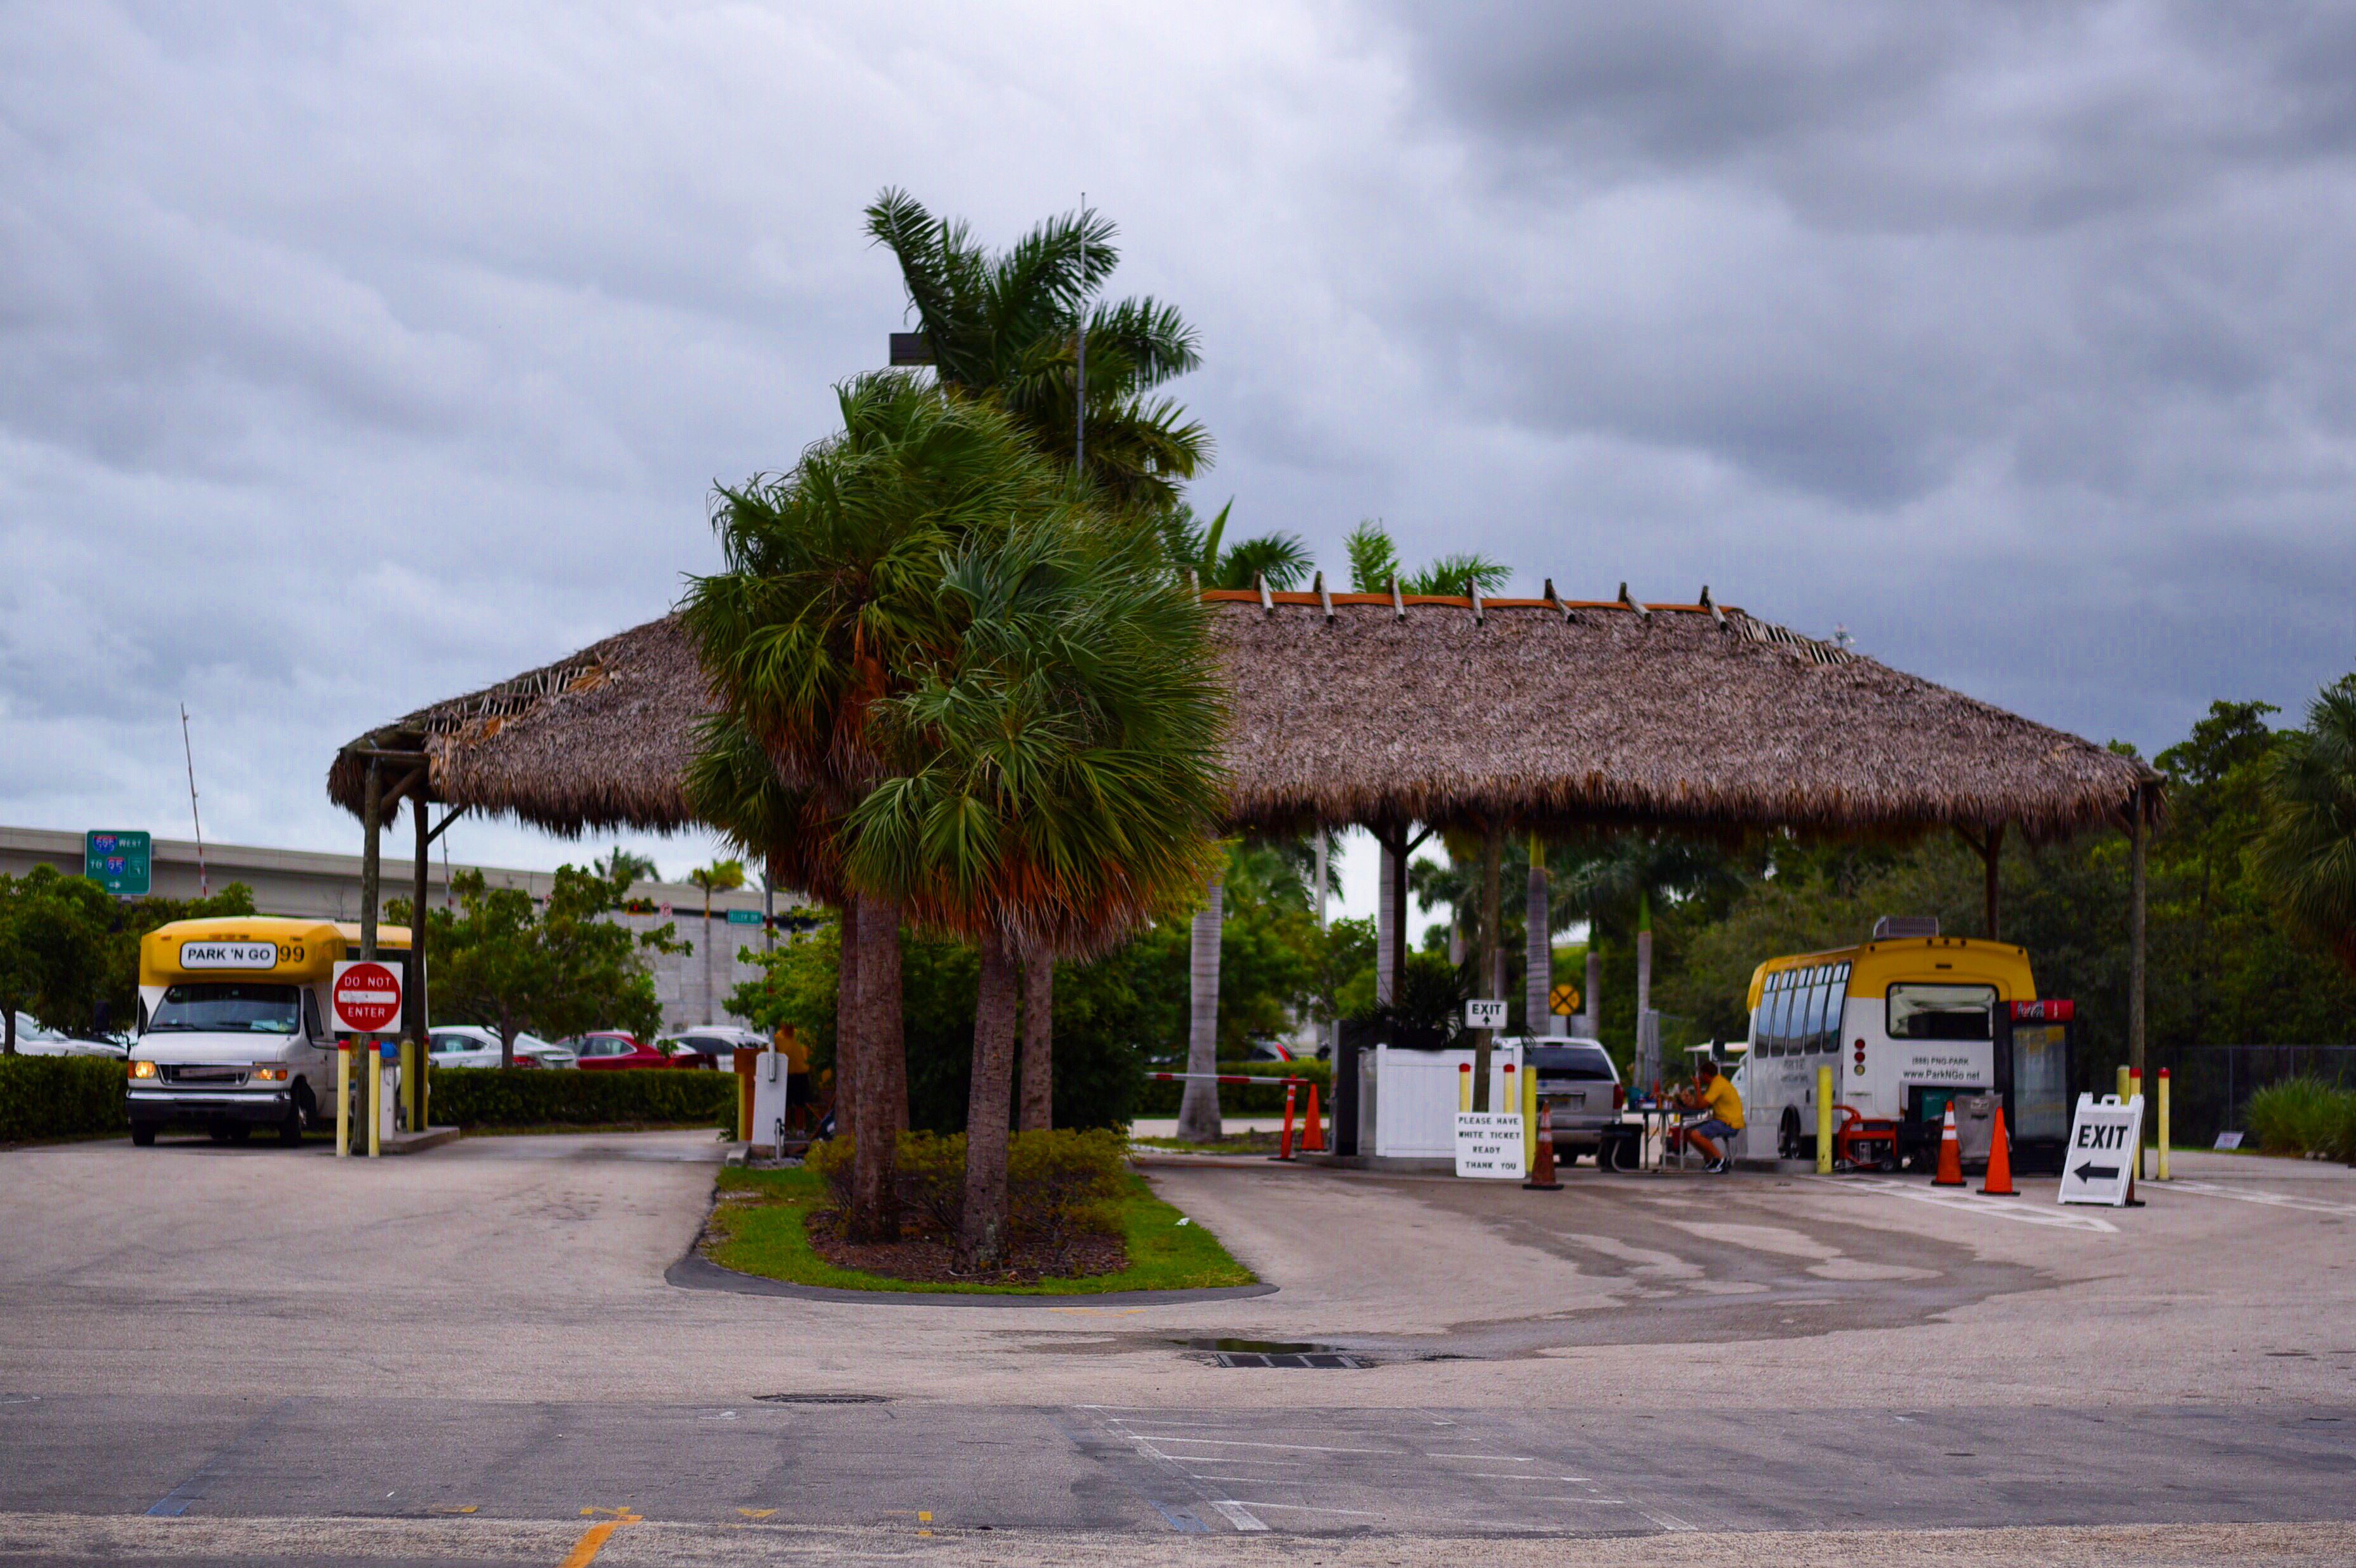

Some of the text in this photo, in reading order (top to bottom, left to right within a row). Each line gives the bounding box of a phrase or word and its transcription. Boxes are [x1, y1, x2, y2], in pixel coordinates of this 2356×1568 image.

[118, 839, 142, 848] WEST
[90, 859, 102, 869] TO
[188, 949, 226, 961] PARK
[248, 949, 271, 961] GO
[279, 945, 305, 963] 99
[345, 976, 391, 988] DO NOT
[348, 1006, 385, 1018] ENTER
[1472, 1004, 1501, 1016] EXIT
[1912, 1056, 1929, 1066] (888)
[1903, 1069, 1980, 1081] www.ParkNGonet
[1490, 1131, 1520, 1140] TICKET
[2077, 1125, 2128, 1150] EXIT
[1472, 1146, 1501, 1154] READY
